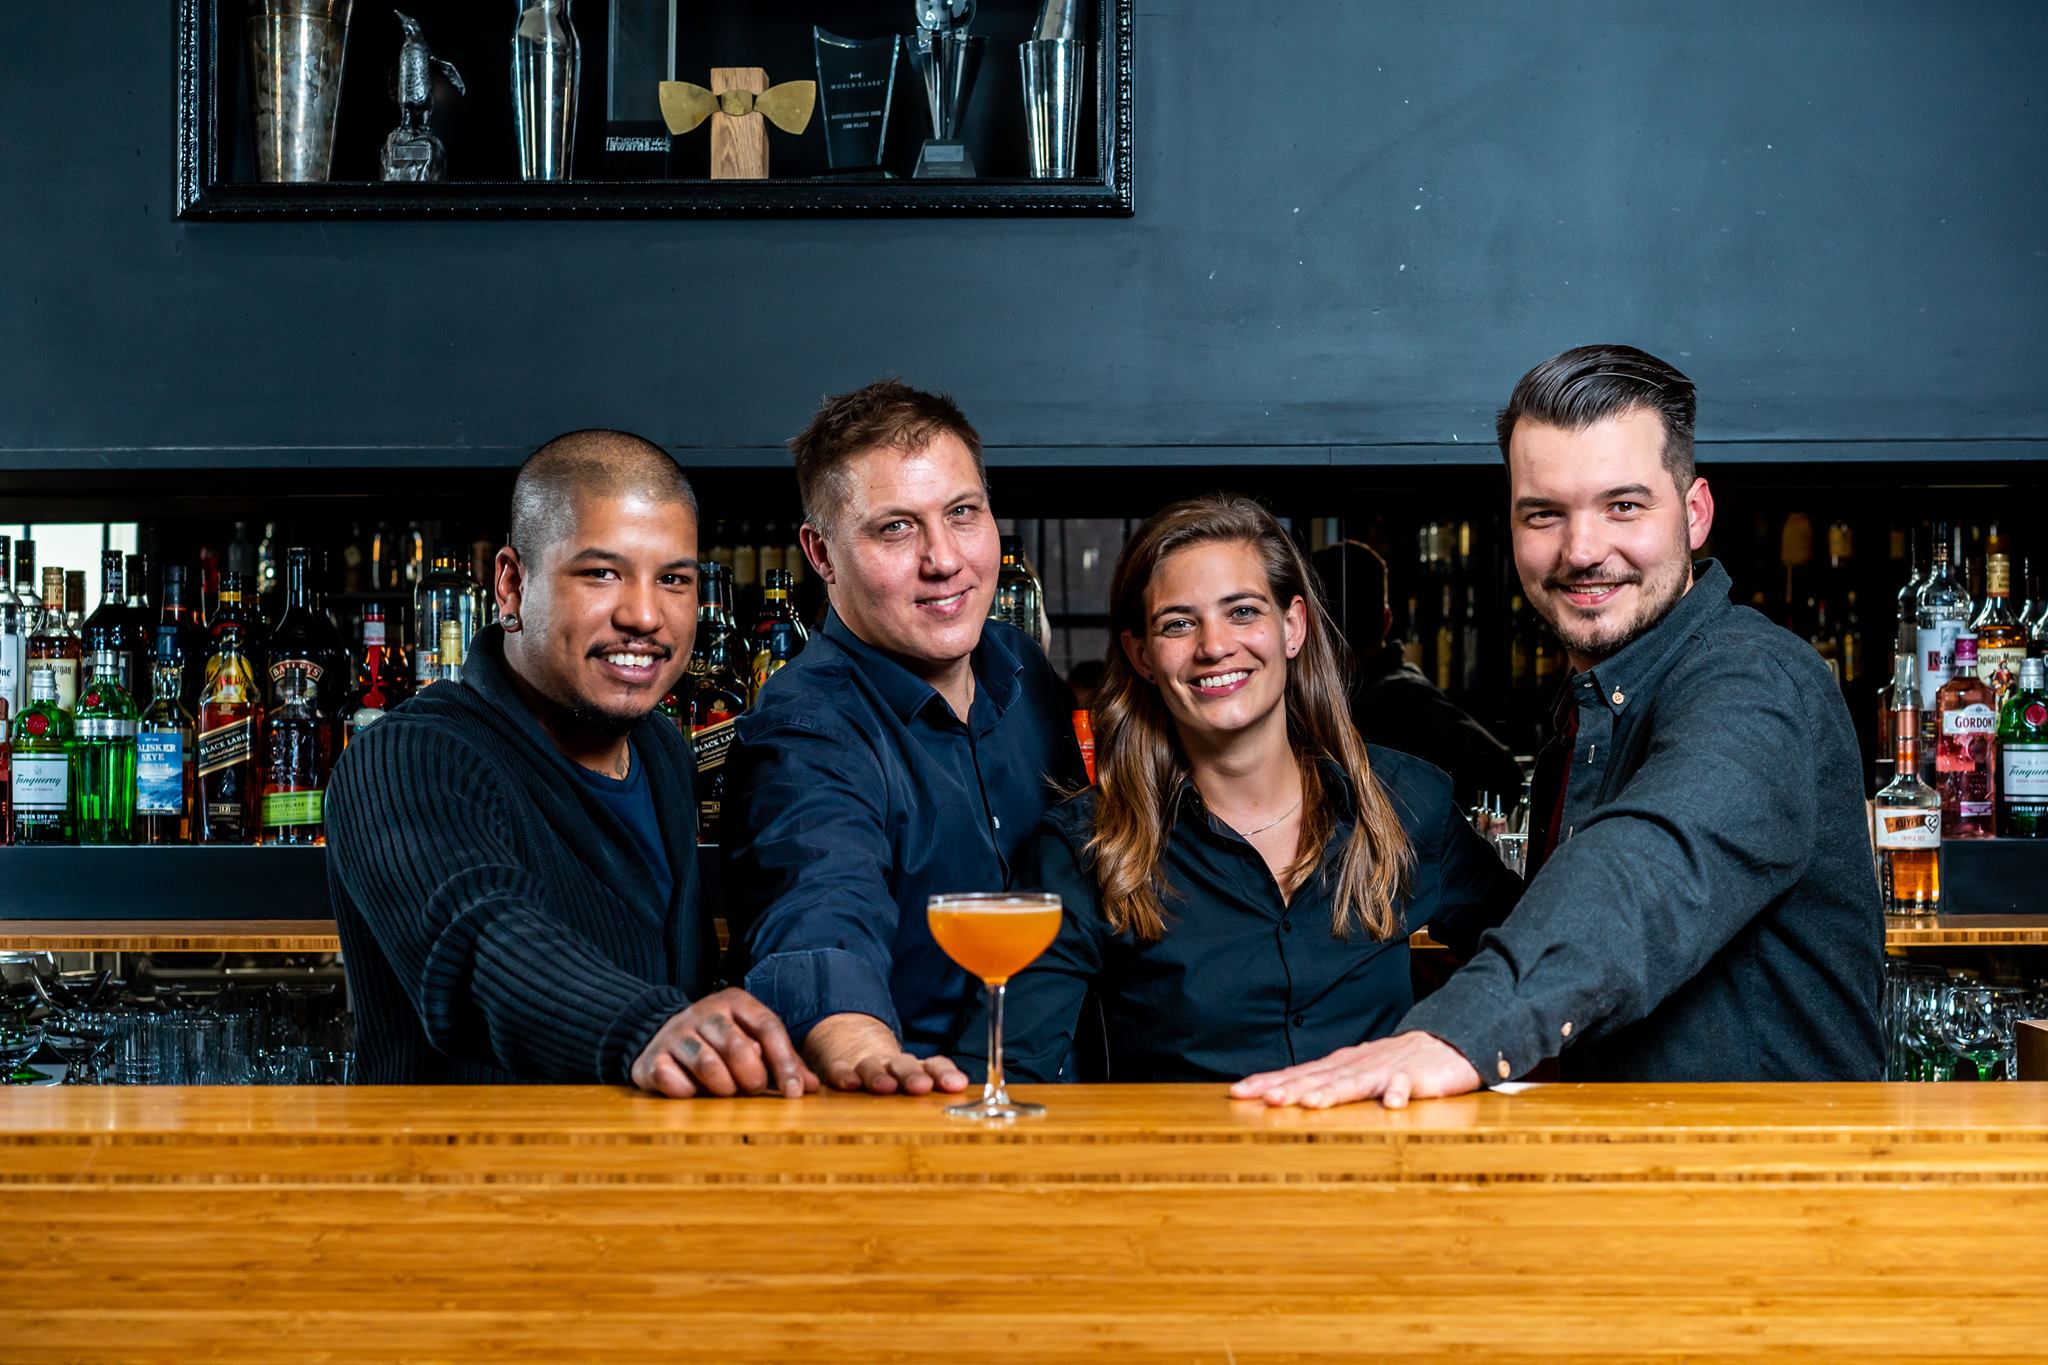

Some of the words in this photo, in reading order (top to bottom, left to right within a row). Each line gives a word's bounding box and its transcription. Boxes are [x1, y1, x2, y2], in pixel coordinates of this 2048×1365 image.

[830, 82, 856, 90] WORLD
[857, 80, 881, 88] CLASS
[1978, 654, 2001, 666] Captain
[137, 743, 177, 753] ALISKER
[200, 740, 227, 756] BLACK
[227, 732, 252, 746] LABEL
[694, 739, 719, 753] BLACK
[141, 752, 165, 762] SKYE
[15, 773, 62, 787] Tanqueray
[2011, 805, 2032, 813] LONDON
[17, 813, 36, 821] LONDON
[37, 813, 48, 821] DRY
